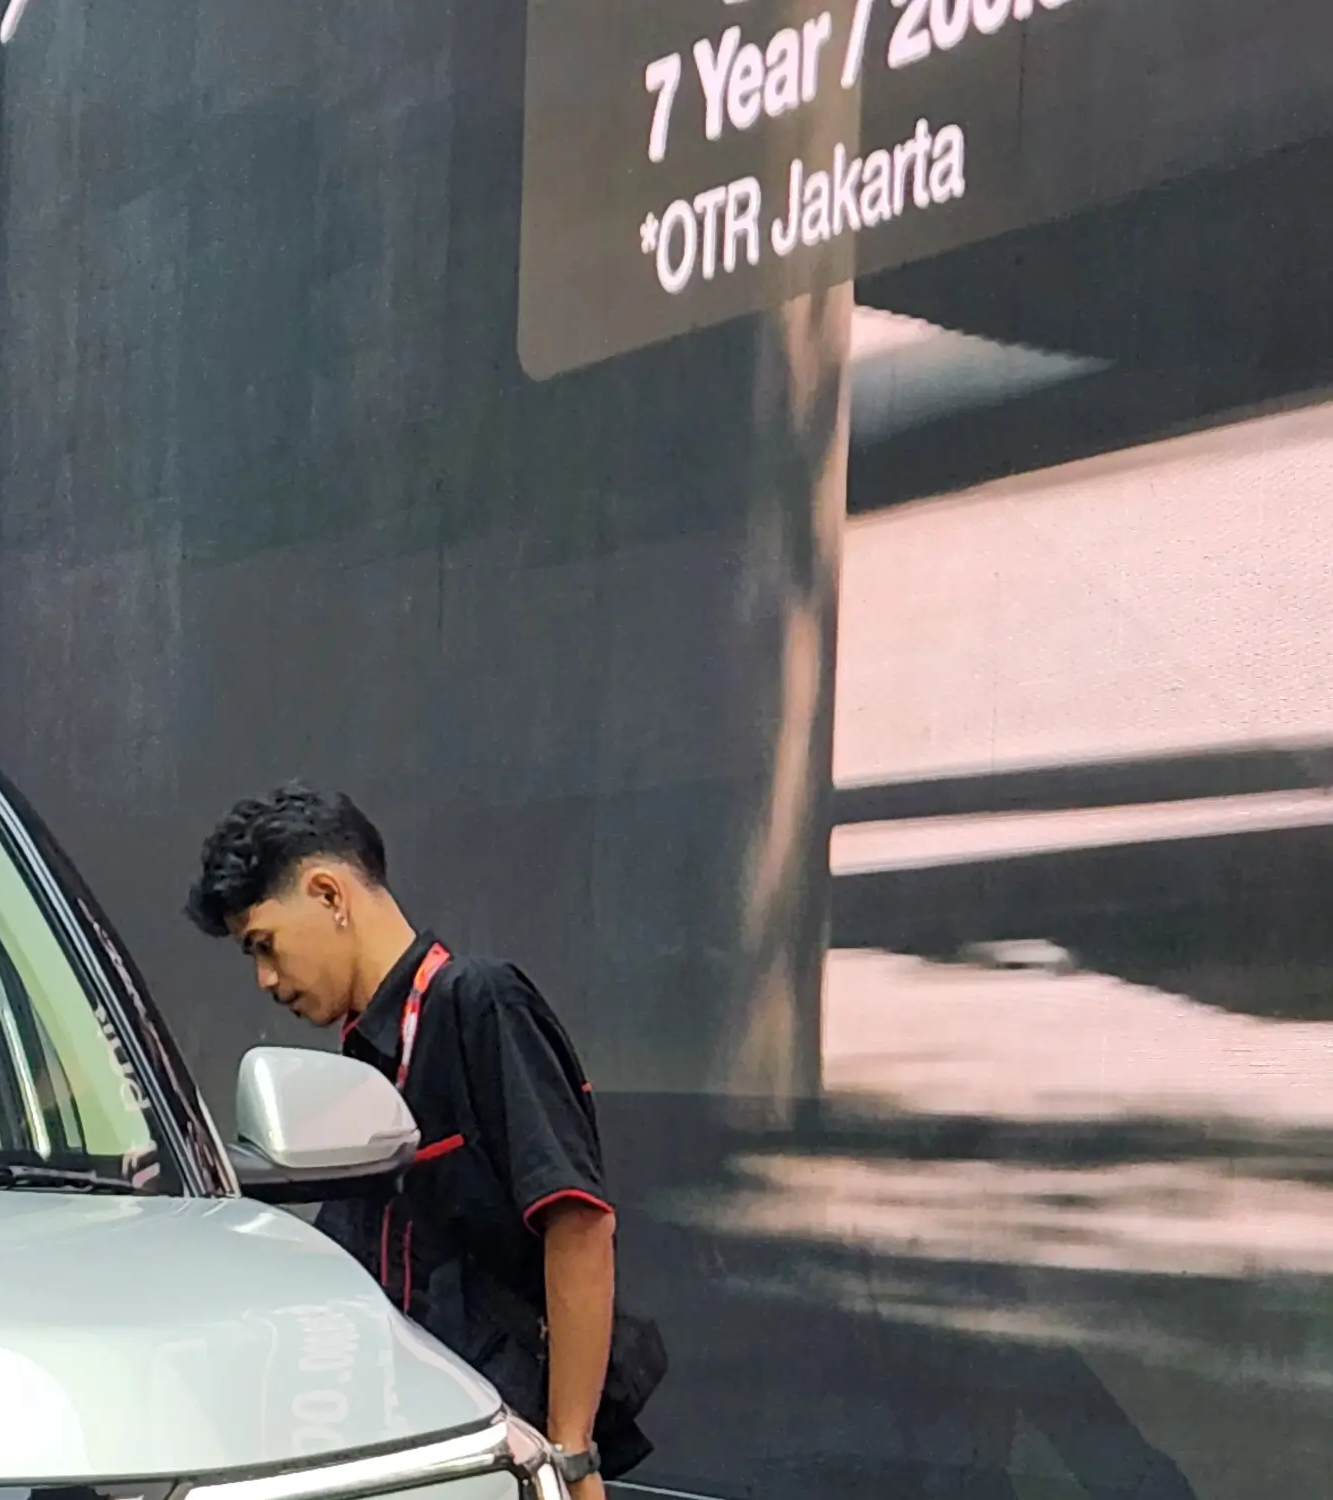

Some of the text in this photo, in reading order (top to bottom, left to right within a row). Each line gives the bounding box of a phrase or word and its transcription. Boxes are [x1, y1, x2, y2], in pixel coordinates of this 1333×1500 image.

[644, 52, 682, 163] 7
[693, 11, 832, 141] Year
[771, 117, 966, 257] Jakarta
